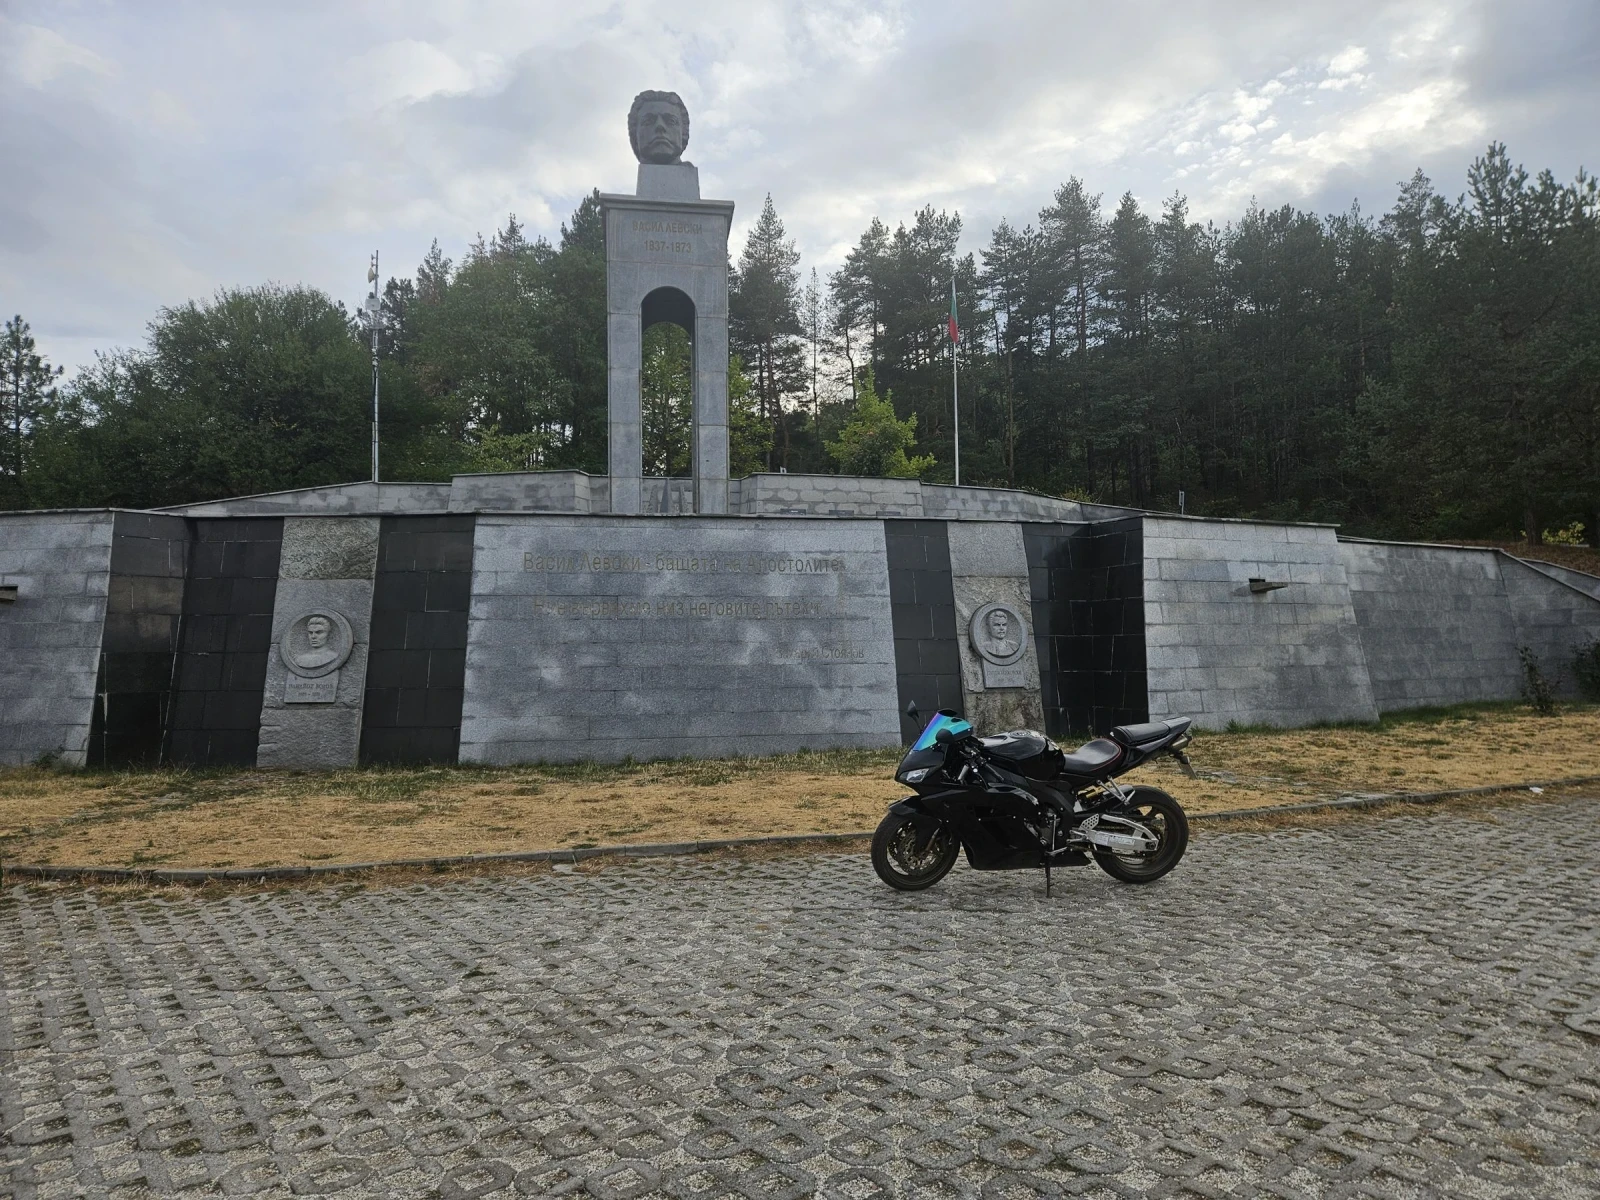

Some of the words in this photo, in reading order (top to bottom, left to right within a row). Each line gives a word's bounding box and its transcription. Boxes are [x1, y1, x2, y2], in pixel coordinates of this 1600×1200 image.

[632, 221, 664, 232] ВАСИЛ
[665, 222, 703, 235] ЛЕВСКИ
[523, 551, 575, 572] Васил
[579, 551, 640, 572] Левски
[655, 553, 719, 574] бащата
[690, 602, 760, 616] неговите
